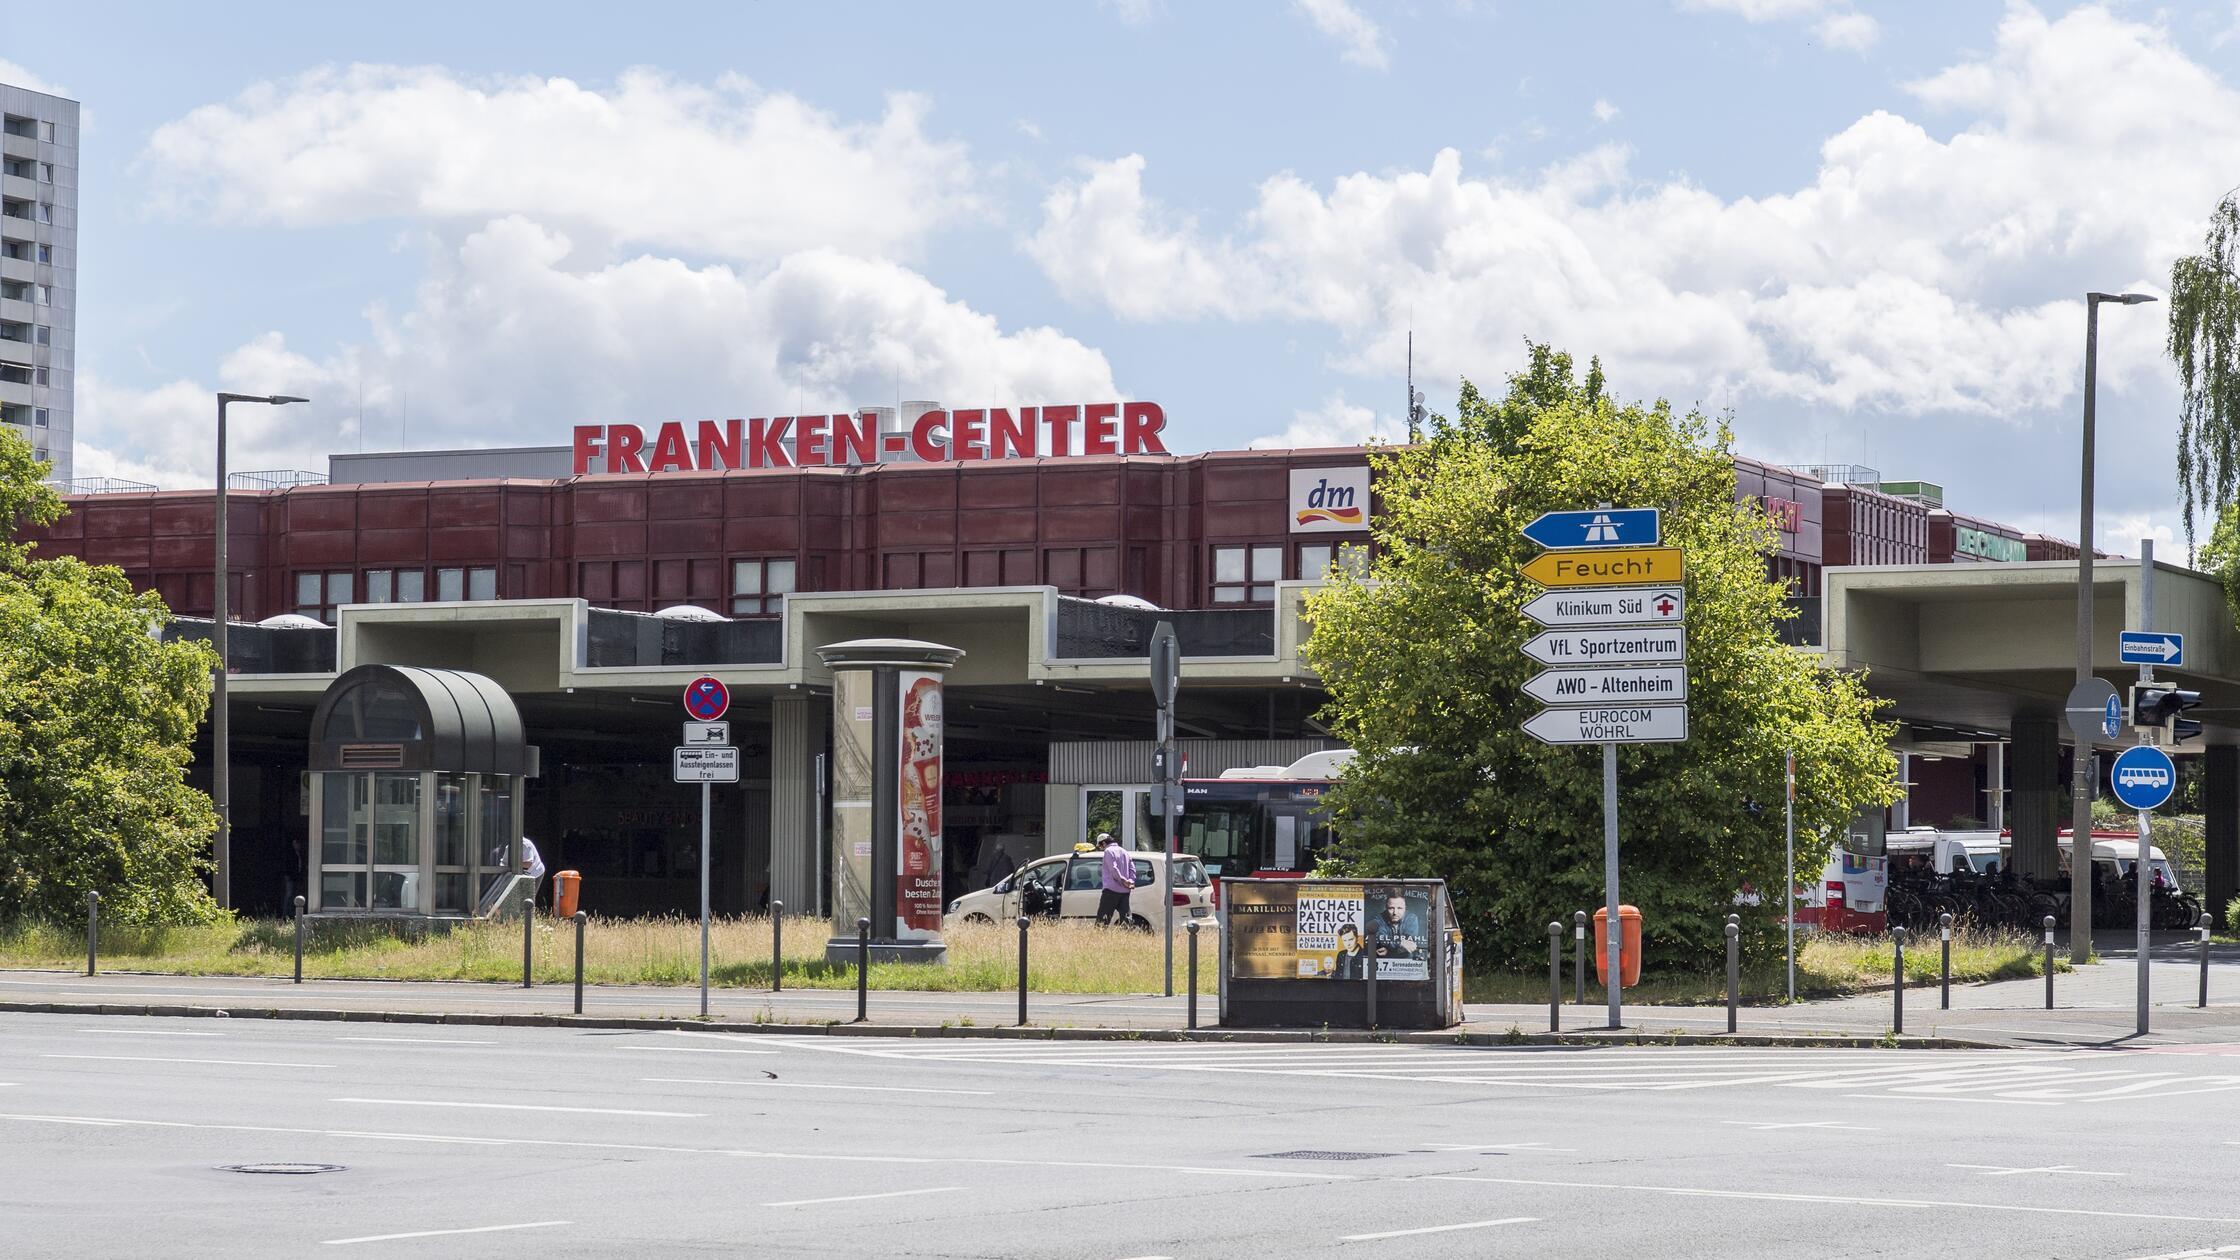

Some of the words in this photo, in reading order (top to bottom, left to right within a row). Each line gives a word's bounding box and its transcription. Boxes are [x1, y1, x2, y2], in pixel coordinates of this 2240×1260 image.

[573, 402, 1167, 474] FRANKEN-CENTER
[1307, 478, 1355, 509] dm
[1556, 557, 1654, 577] Feucht
[1556, 600, 1613, 617] Klinikum
[1618, 598, 1643, 615] Süd
[1549, 639, 1573, 656] VfL
[1579, 637, 1677, 659] Sportzentrum
[2124, 643, 2166, 654] Einbahnstraße
[1555, 677, 1587, 695] AWO
[1601, 675, 1673, 694] Altenheim
[1579, 709, 1652, 724] EUROCOM
[1580, 724, 1635, 739] WÖHRL
[704, 751, 719, 759] Ein-
[721, 750, 734, 759] und
[679, 760, 734, 770] Aussteigenlassen
[699, 770, 714, 779] frei
[904, 889, 931, 899] besten
[1403, 889, 1429, 900] MEHR
[1238, 905, 1295, 913] MARILLION
[1299, 899, 1362, 911] MICHAEL
[1299, 911, 1356, 923] PATRICK
[1299, 922, 1337, 934] KELLY
[1299, 941, 1336, 949] KÜMMERT
